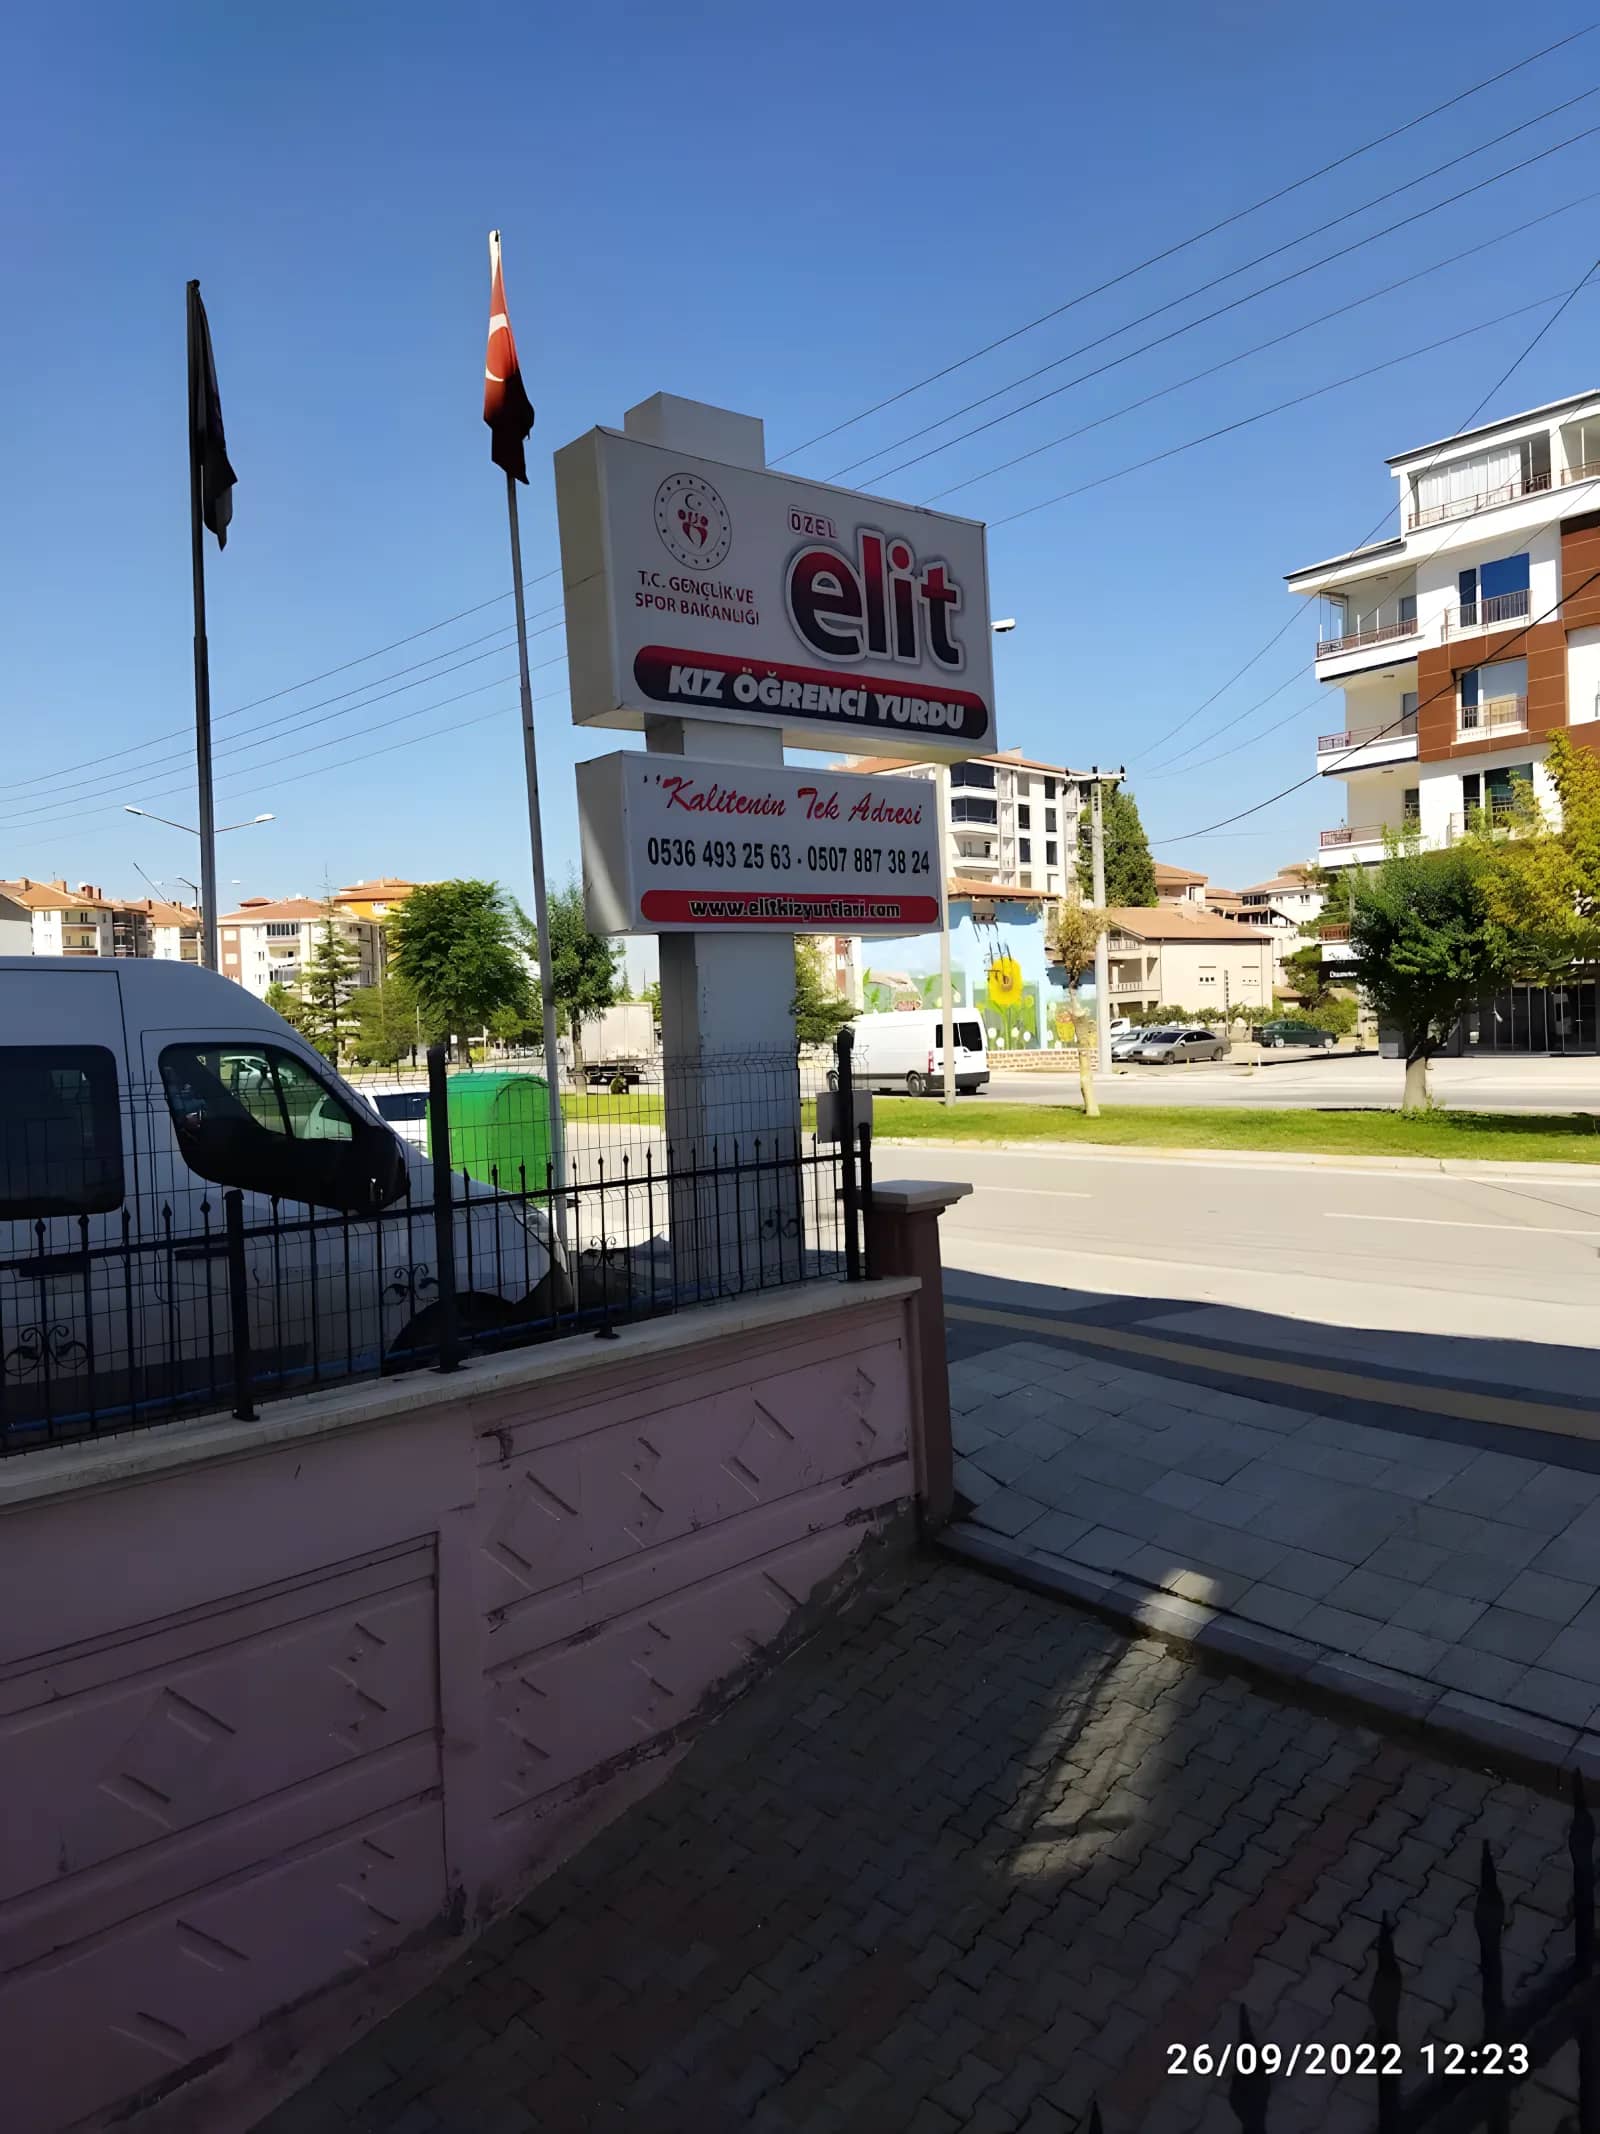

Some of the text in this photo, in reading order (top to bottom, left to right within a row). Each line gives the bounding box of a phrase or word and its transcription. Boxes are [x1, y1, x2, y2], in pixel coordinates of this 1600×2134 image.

[638, 570, 754, 604] T.C. GENÇLİK VE
[788, 530, 963, 668] elit
[635, 592, 760, 626] SPOR BAKANLIĞI
[668, 665, 965, 729] KIZ ÖĞRENCİ YURDU
[797, 787, 840, 820] Tek
[847, 792, 923, 825] Adresi
[647, 837, 696, 867] 0536
[702, 840, 737, 868] 493
[742, 842, 764, 869] 25
[770, 844, 791, 870] 63
[807, 845, 848, 872] 0507
[854, 847, 882, 873] 887
[887, 848, 906, 874] 38
[911, 850, 930, 875] 24
